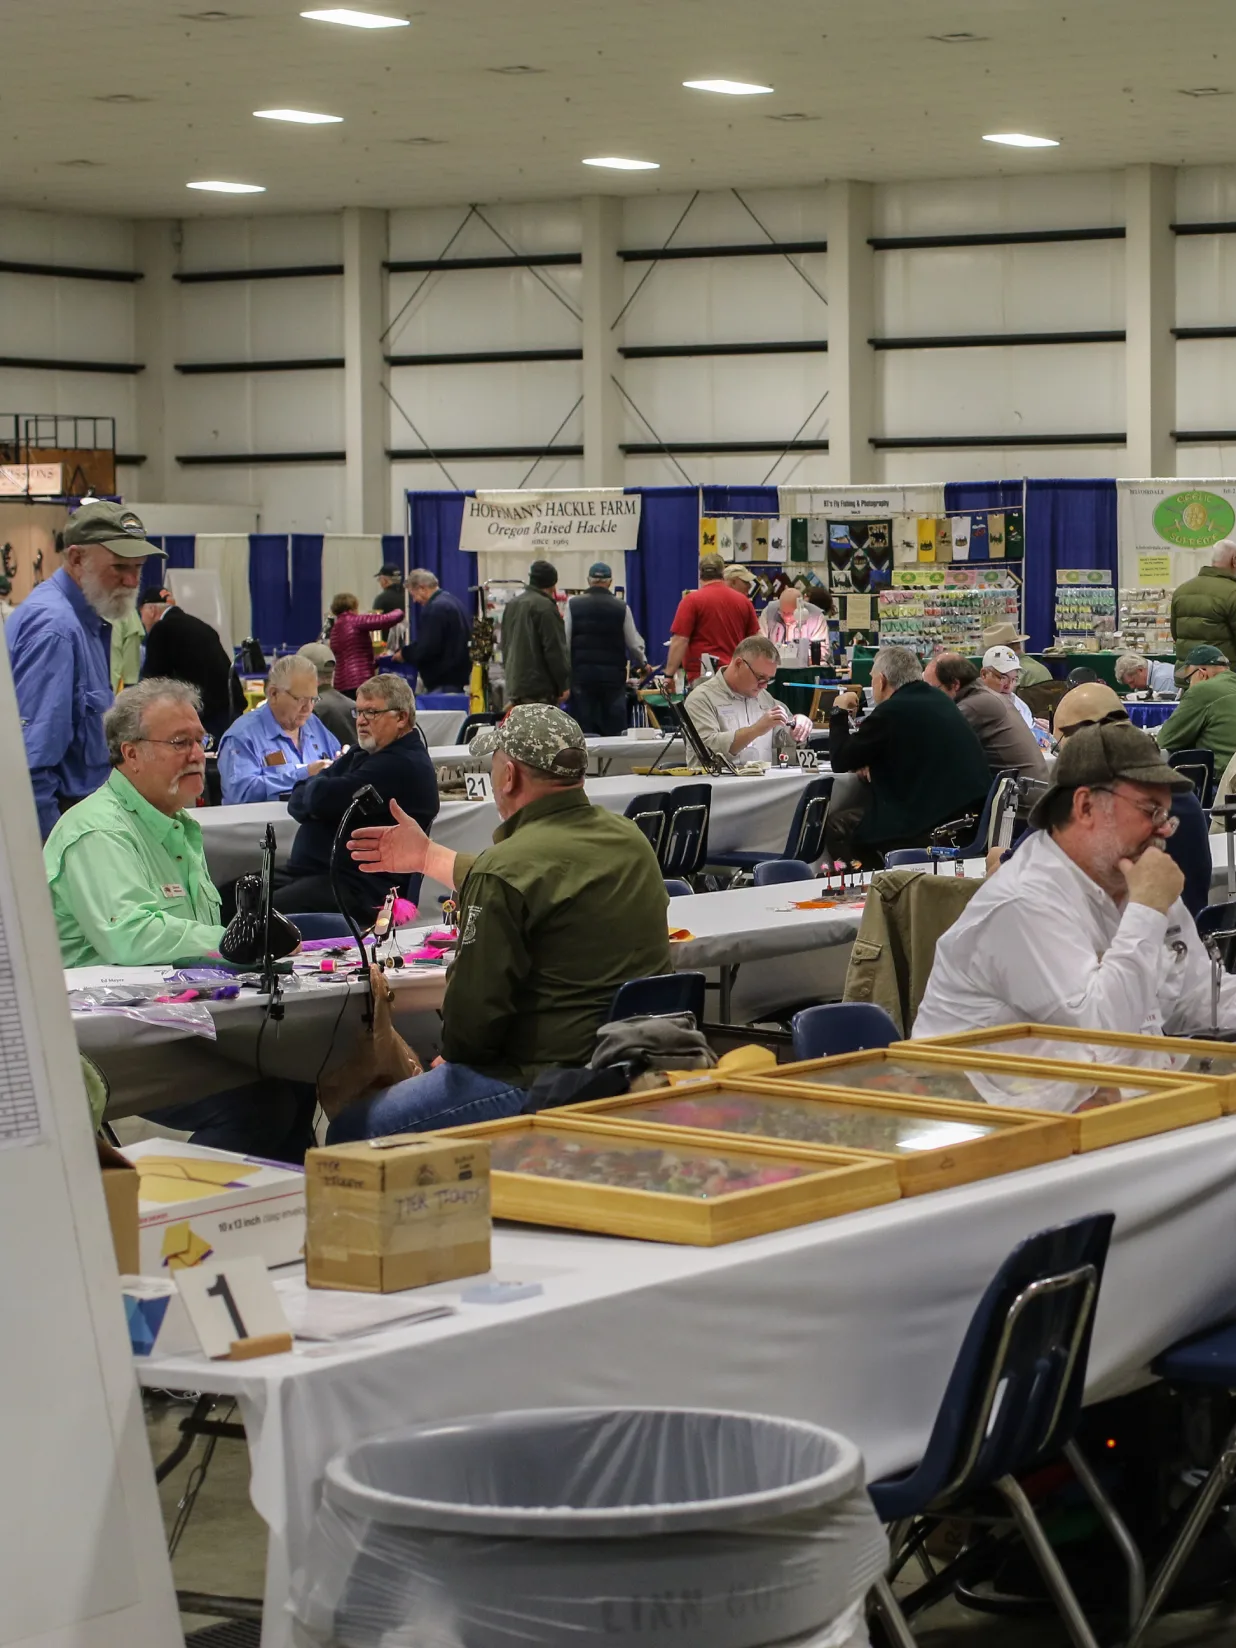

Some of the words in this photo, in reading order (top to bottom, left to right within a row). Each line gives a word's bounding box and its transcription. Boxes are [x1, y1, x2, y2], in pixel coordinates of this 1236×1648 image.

[470, 501, 542, 520] HOFFMAN'S
[546, 501, 596, 517] HACKLE
[600, 500, 636, 516] FARM
[841, 500, 856, 508] Fishing
[861, 500, 889, 508] Photography
[488, 522, 529, 538] Oregon
[533, 521, 572, 534] Raised
[576, 520, 618, 534] Hackle
[800, 751, 817, 768] 22
[467, 777, 486, 796] 21
[218, 1223, 227, 1232] 10
[244, 1216, 262, 1226] inch
[206, 1274, 248, 1339] 1
